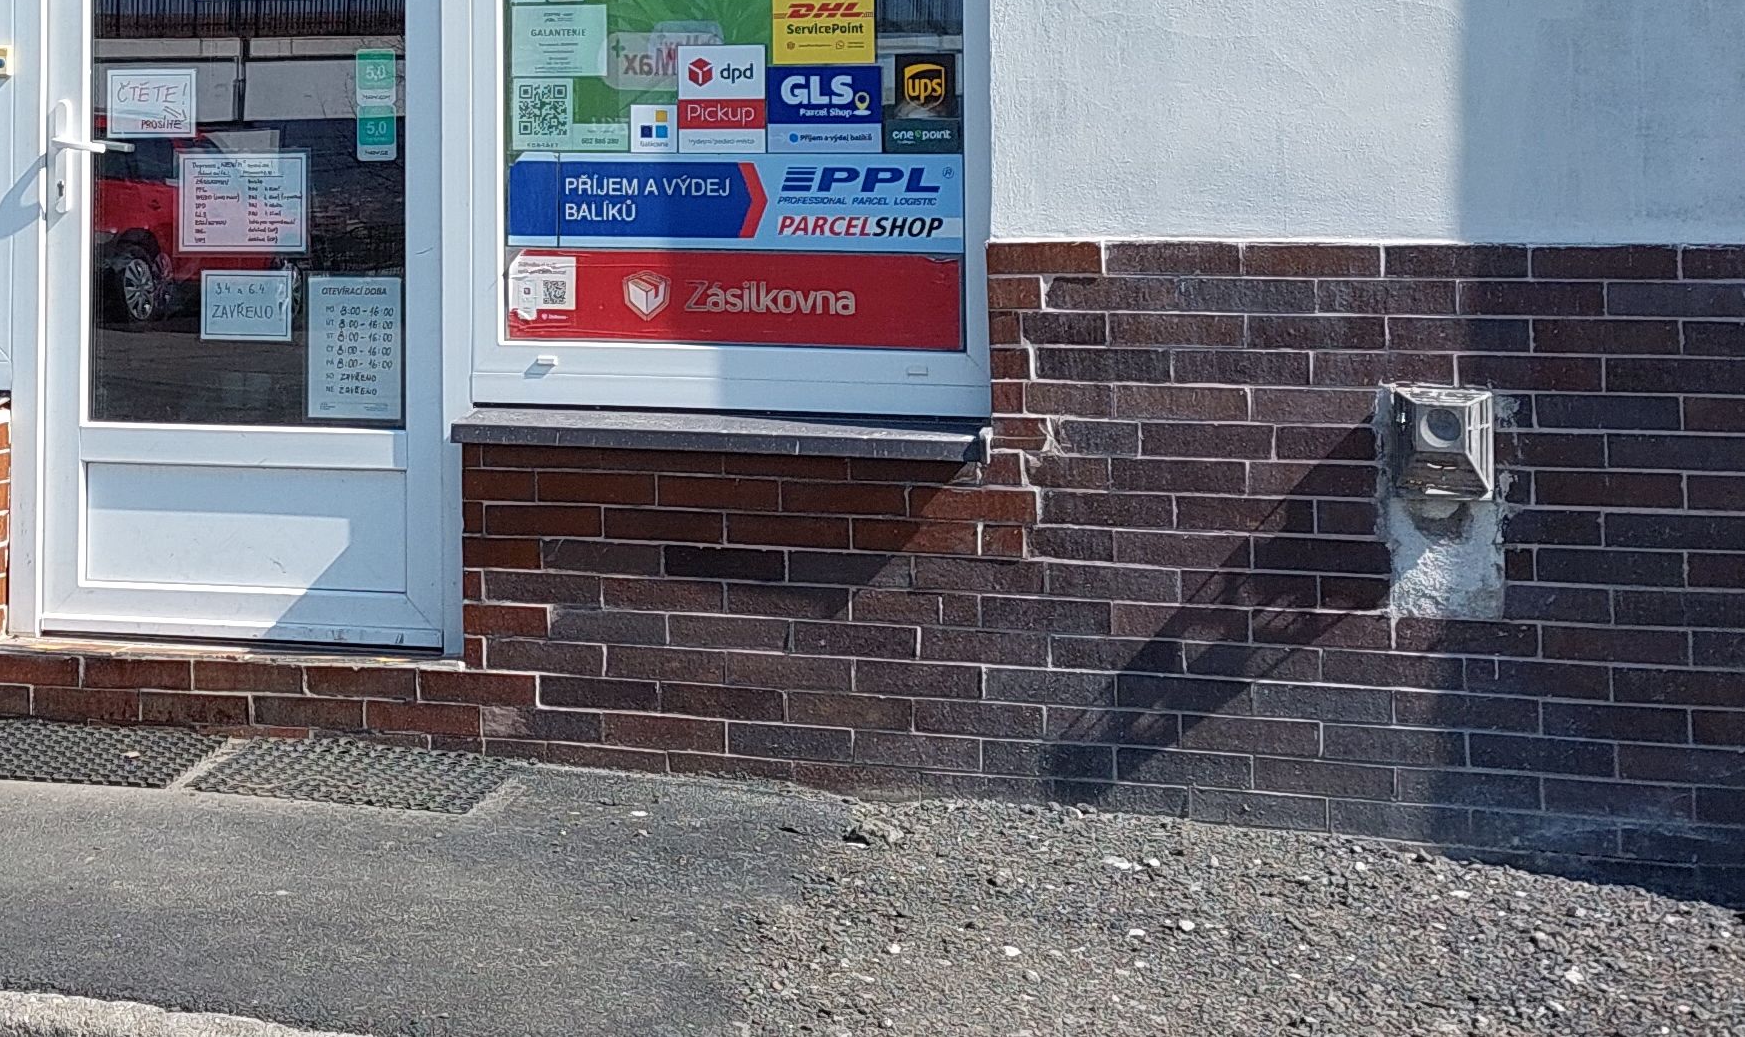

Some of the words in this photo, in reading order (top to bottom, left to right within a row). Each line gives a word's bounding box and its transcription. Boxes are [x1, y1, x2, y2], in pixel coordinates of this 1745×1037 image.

[787, 3, 863, 18] DHL
[531, 29, 587, 37] GALANTERIE
[787, 23, 864, 35] ServicePoint
[720, 63, 754, 83] dpd
[780, 75, 854, 104] GLS
[907, 79, 942, 102] ups
[687, 104, 755, 126] Pickup
[800, 108, 827, 116] Parcel
[830, 108, 852, 118] Shop
[366, 121, 387, 136] 5,0
[565, 174, 638, 195] PŘÍJEM
[644, 179, 658, 195] A
[663, 175, 730, 196] VÝDEJ
[817, 167, 941, 193] PPL
[565, 200, 636, 221] BALÍKŮ
[777, 196, 847, 205] PROFESSIONAL
[852, 197, 889, 205] PARCEL
[894, 198, 937, 206] LOGISTIC
[778, 216, 943, 238] PARCELSHOP
[322, 286, 363, 295] OTEVÍRACÍ
[365, 287, 387, 295] DOBA
[685, 280, 856, 315] Zásilkovna
